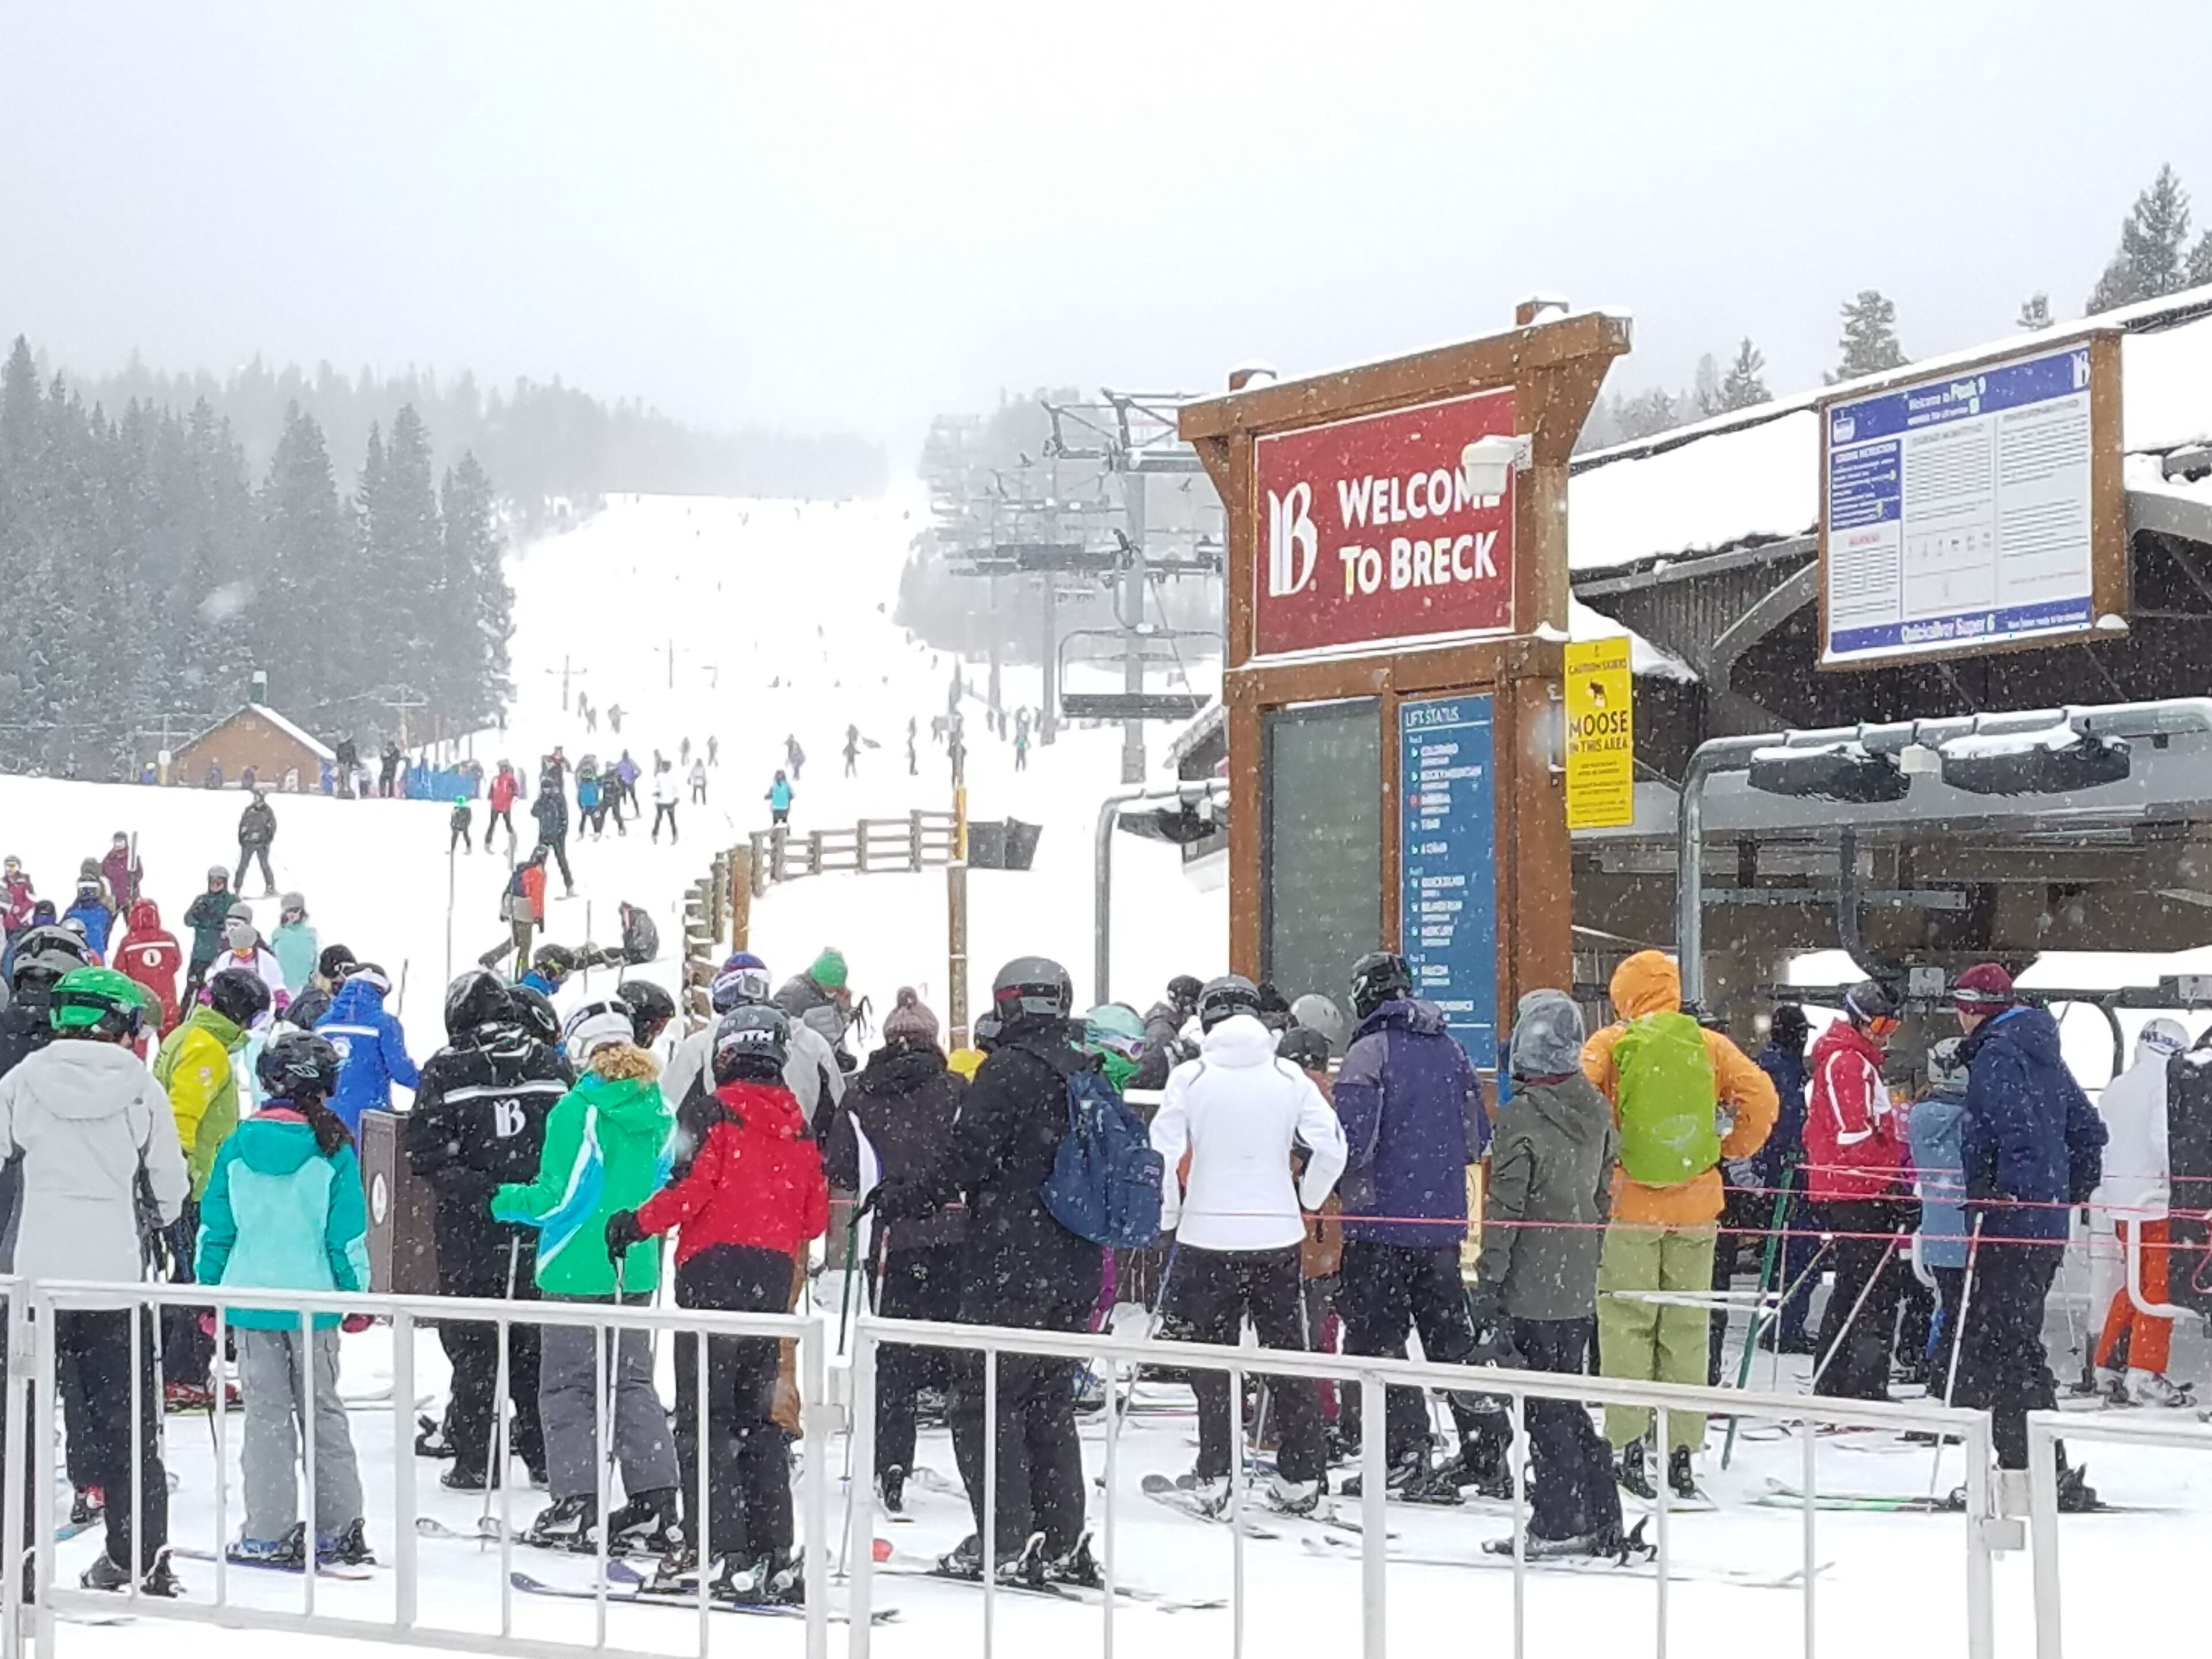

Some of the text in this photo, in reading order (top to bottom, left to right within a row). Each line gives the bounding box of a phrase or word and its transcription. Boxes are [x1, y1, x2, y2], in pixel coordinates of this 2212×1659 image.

[1338, 467, 1501, 530] WELCOM
[1339, 531, 1499, 597] TO BRECK
[1569, 710, 1628, 739] MOOSE
